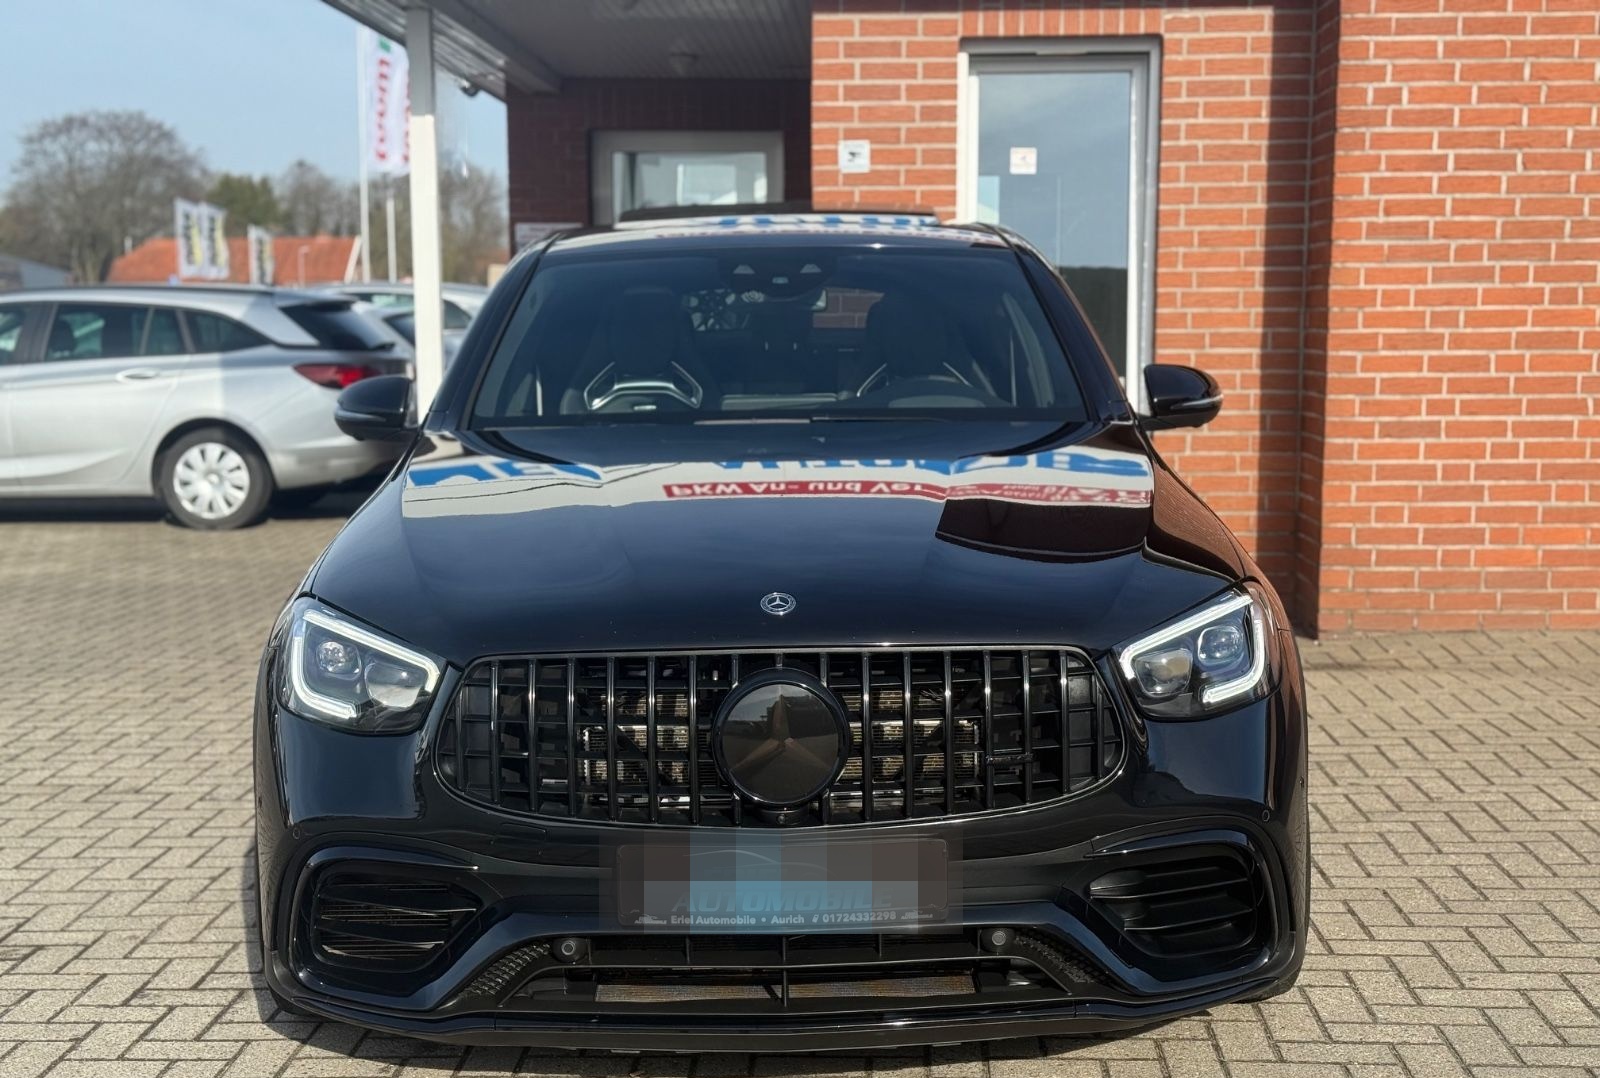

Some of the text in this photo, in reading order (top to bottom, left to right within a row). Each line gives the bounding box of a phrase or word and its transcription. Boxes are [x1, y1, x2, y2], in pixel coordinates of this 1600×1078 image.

[696, 914, 756, 925] Automobile
[771, 914, 805, 924] Aurich
[822, 911, 897, 923] 01724332298
